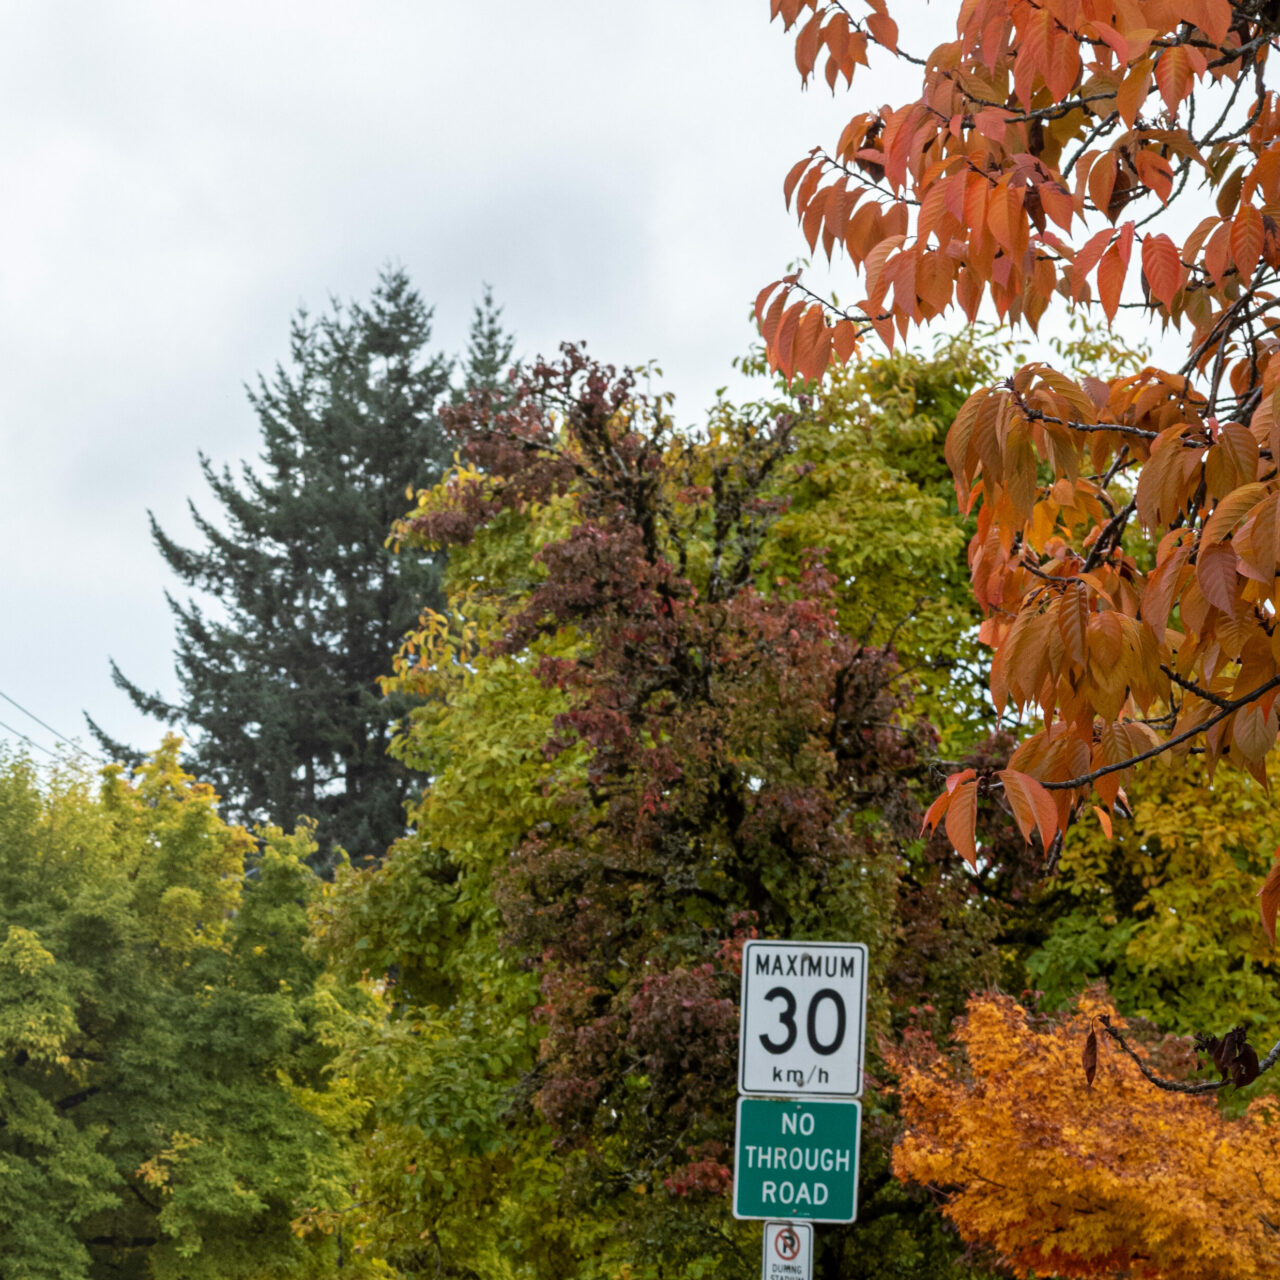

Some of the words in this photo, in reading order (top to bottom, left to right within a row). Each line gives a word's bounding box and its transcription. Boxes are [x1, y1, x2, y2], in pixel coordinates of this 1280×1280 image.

[755, 953, 855, 978] MAXIMUM
[759, 986, 847, 1057] 30
[772, 1065, 829, 1085] km/h
[781, 1112, 815, 1136] NO
[745, 1145, 850, 1172] THROUGH
[762, 1181, 829, 1205] ROAD
[772, 1264, 802, 1274] DURING
